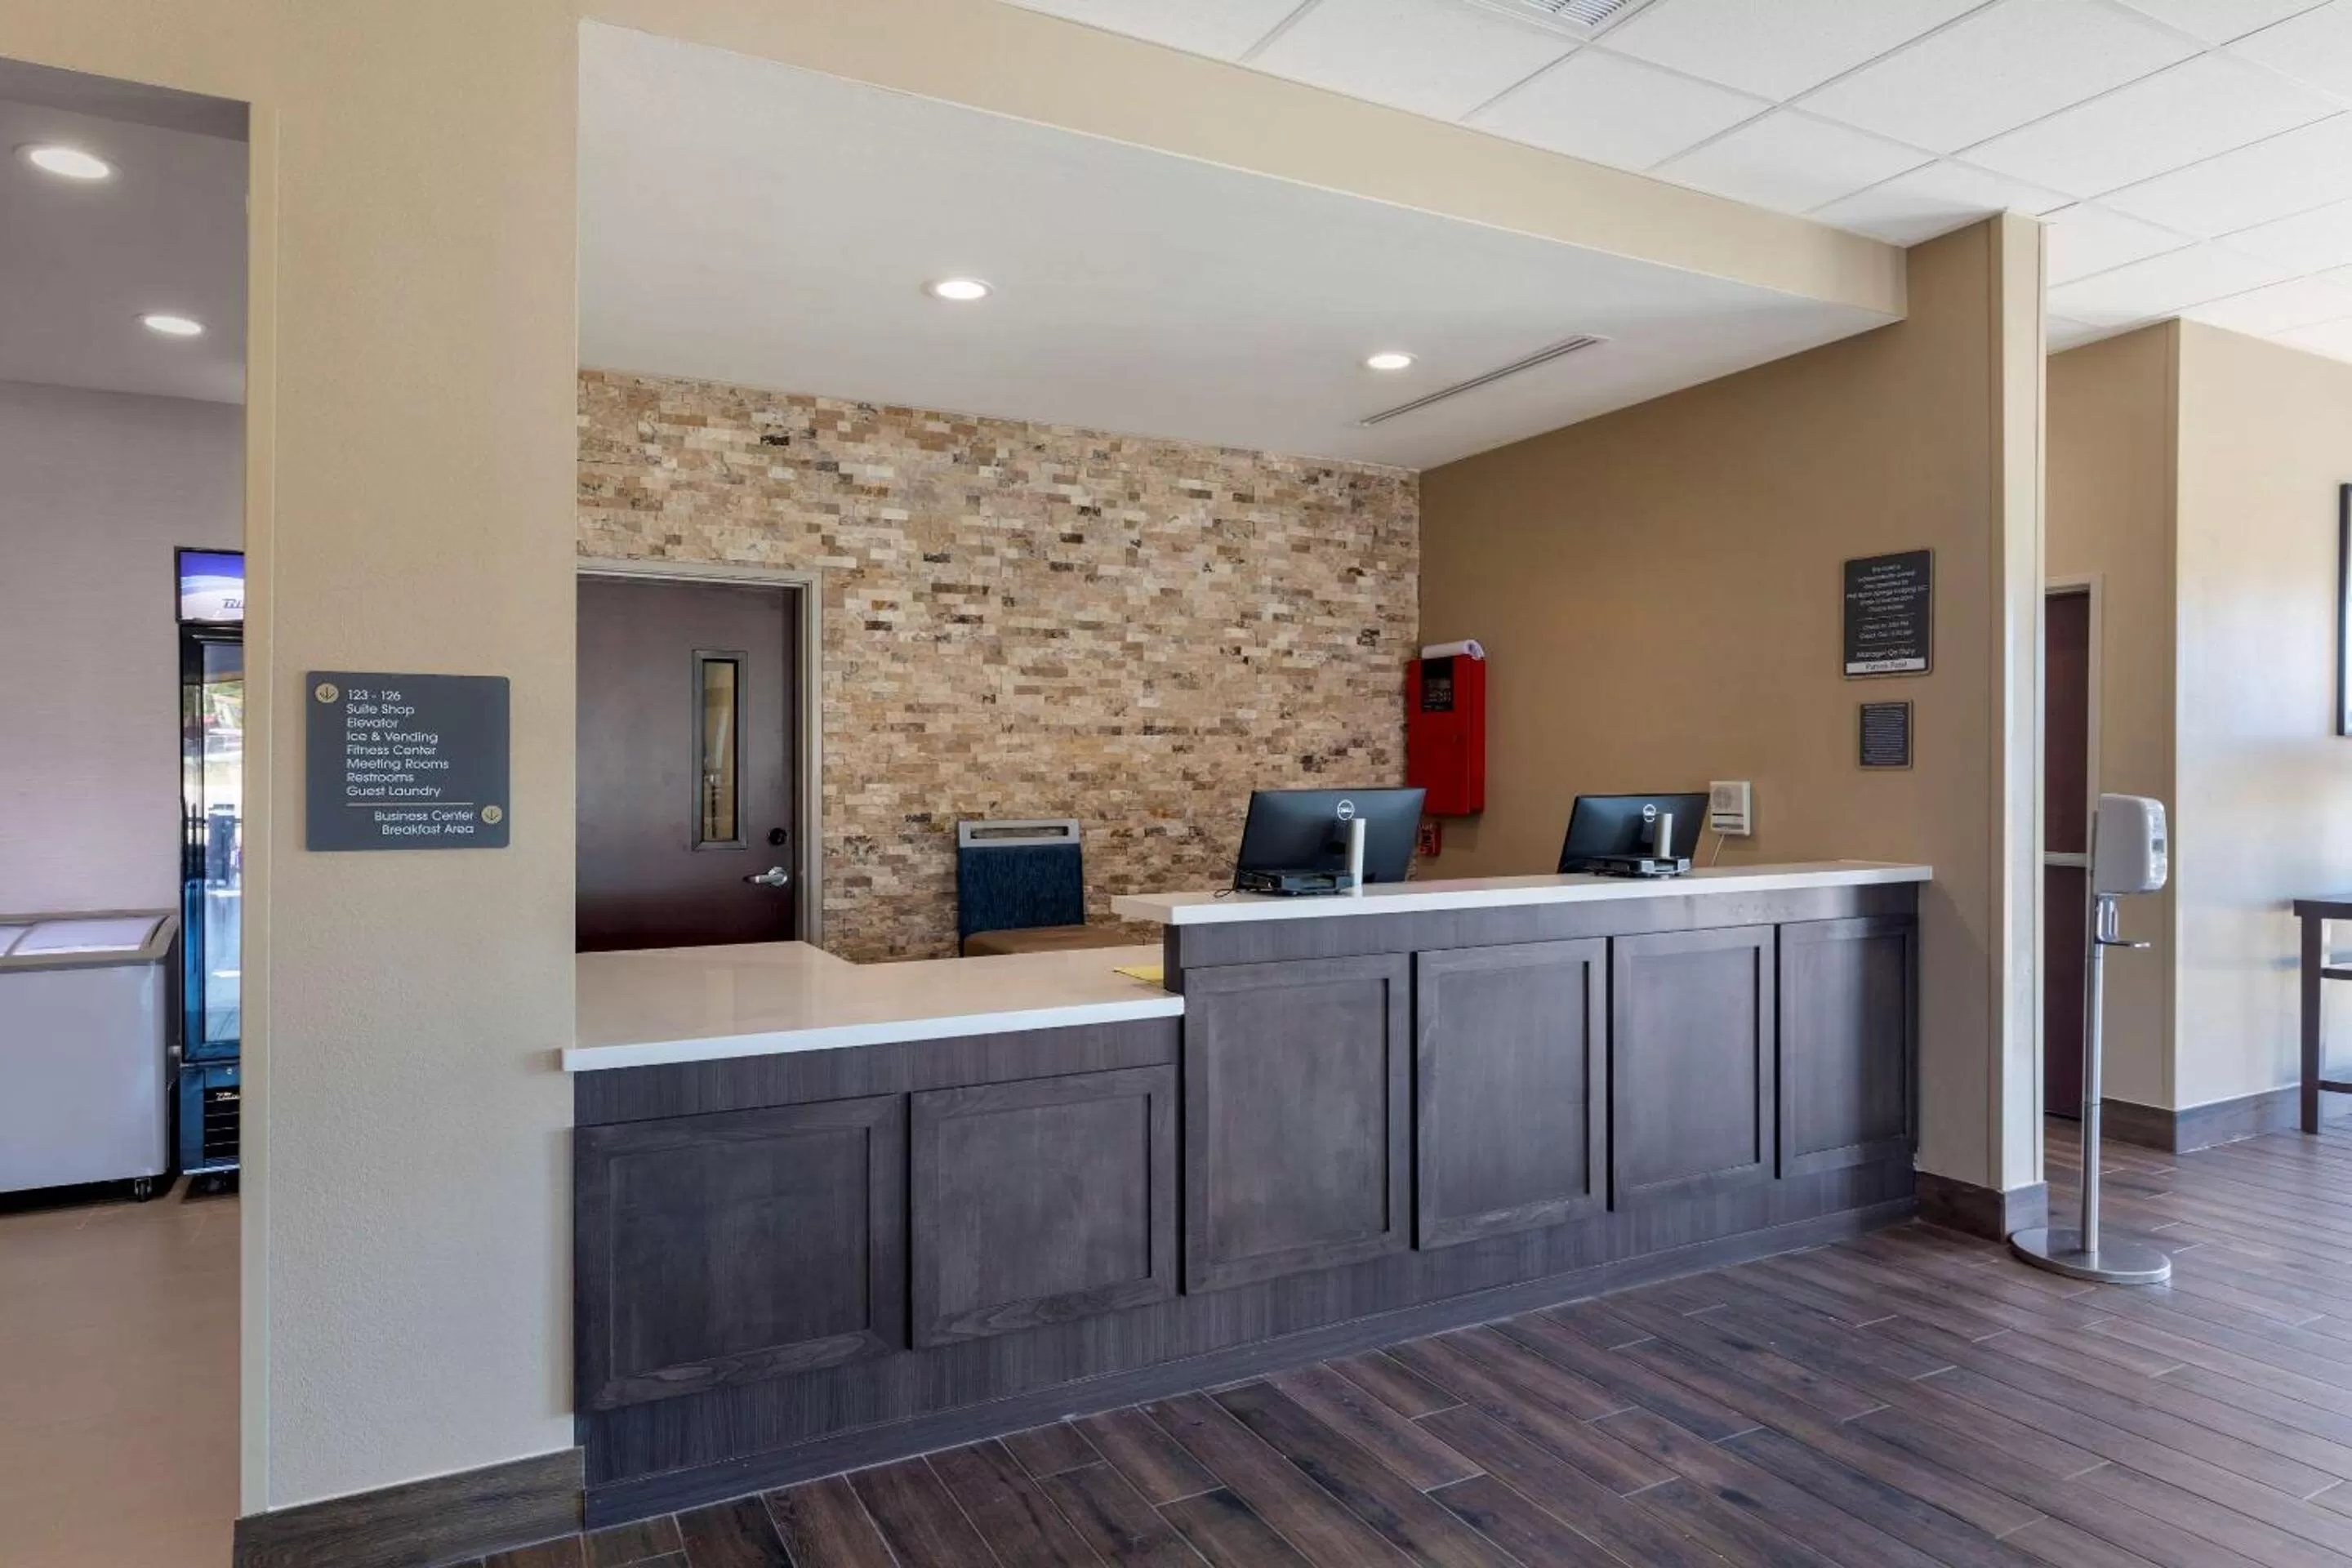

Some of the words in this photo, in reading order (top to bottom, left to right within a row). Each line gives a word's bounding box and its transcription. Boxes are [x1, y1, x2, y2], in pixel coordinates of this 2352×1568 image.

[348, 689, 368, 701] 123
[381, 690, 402, 701] 126
[345, 703, 378, 715] Suite
[381, 703, 415, 716] Shop
[346, 717, 399, 728] Elevator
[346, 731, 368, 742] Ice
[371, 731, 381, 742] &
[383, 731, 439, 744] Vending
[346, 744, 390, 755] Fitness
[392, 745, 437, 755] Center
[346, 758, 402, 771] Meeting
[404, 759, 449, 769] Rooms
[346, 772, 415, 782] Restrooms
[345, 785, 386, 796] Guest
[388, 785, 442, 797] Laundry
[374, 810, 429, 822] Business
[431, 810, 474, 821] Center
[381, 824, 442, 835] Breakfast
[443, 823, 474, 835] Area
